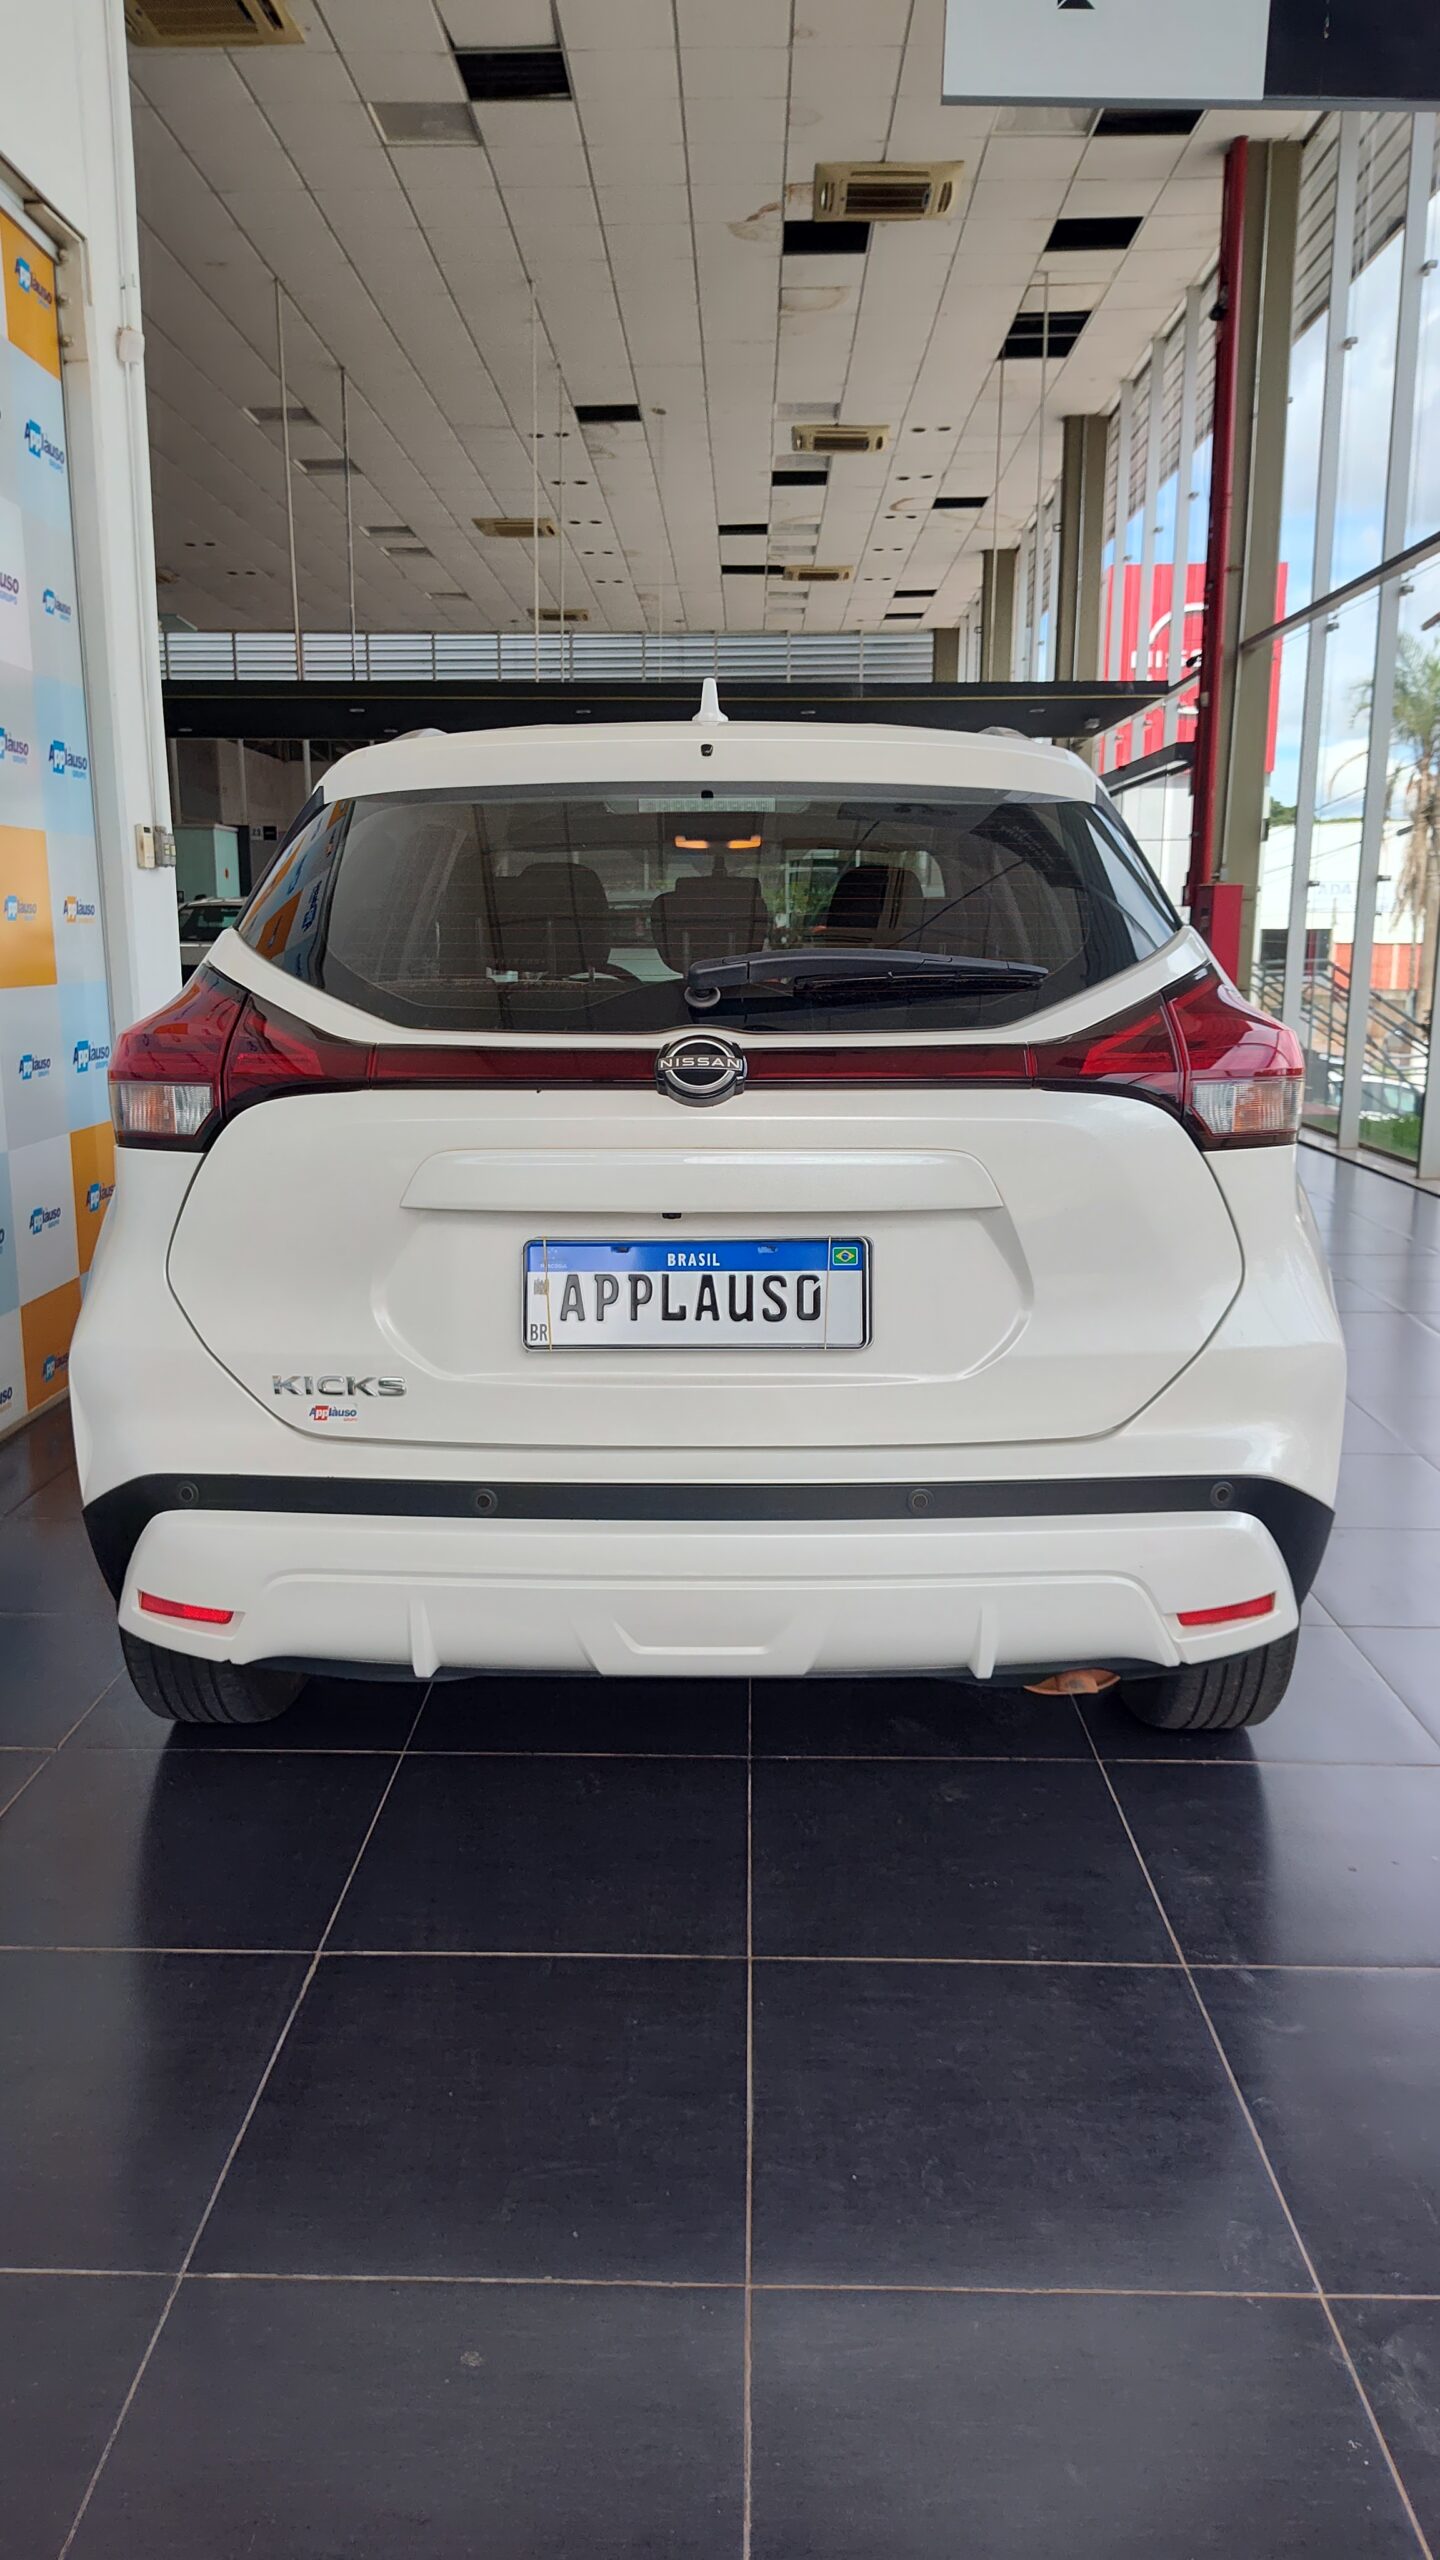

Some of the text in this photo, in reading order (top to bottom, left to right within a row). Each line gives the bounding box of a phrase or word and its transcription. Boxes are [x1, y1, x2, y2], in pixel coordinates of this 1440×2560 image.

[660, 1057, 740, 1069] NISSAN
[667, 1252, 721, 1267] BRASIL
[559, 1274, 822, 1322] APPLAUSO
[530, 1323, 548, 1341] BR
[272, 1374, 407, 1397] KICKS
